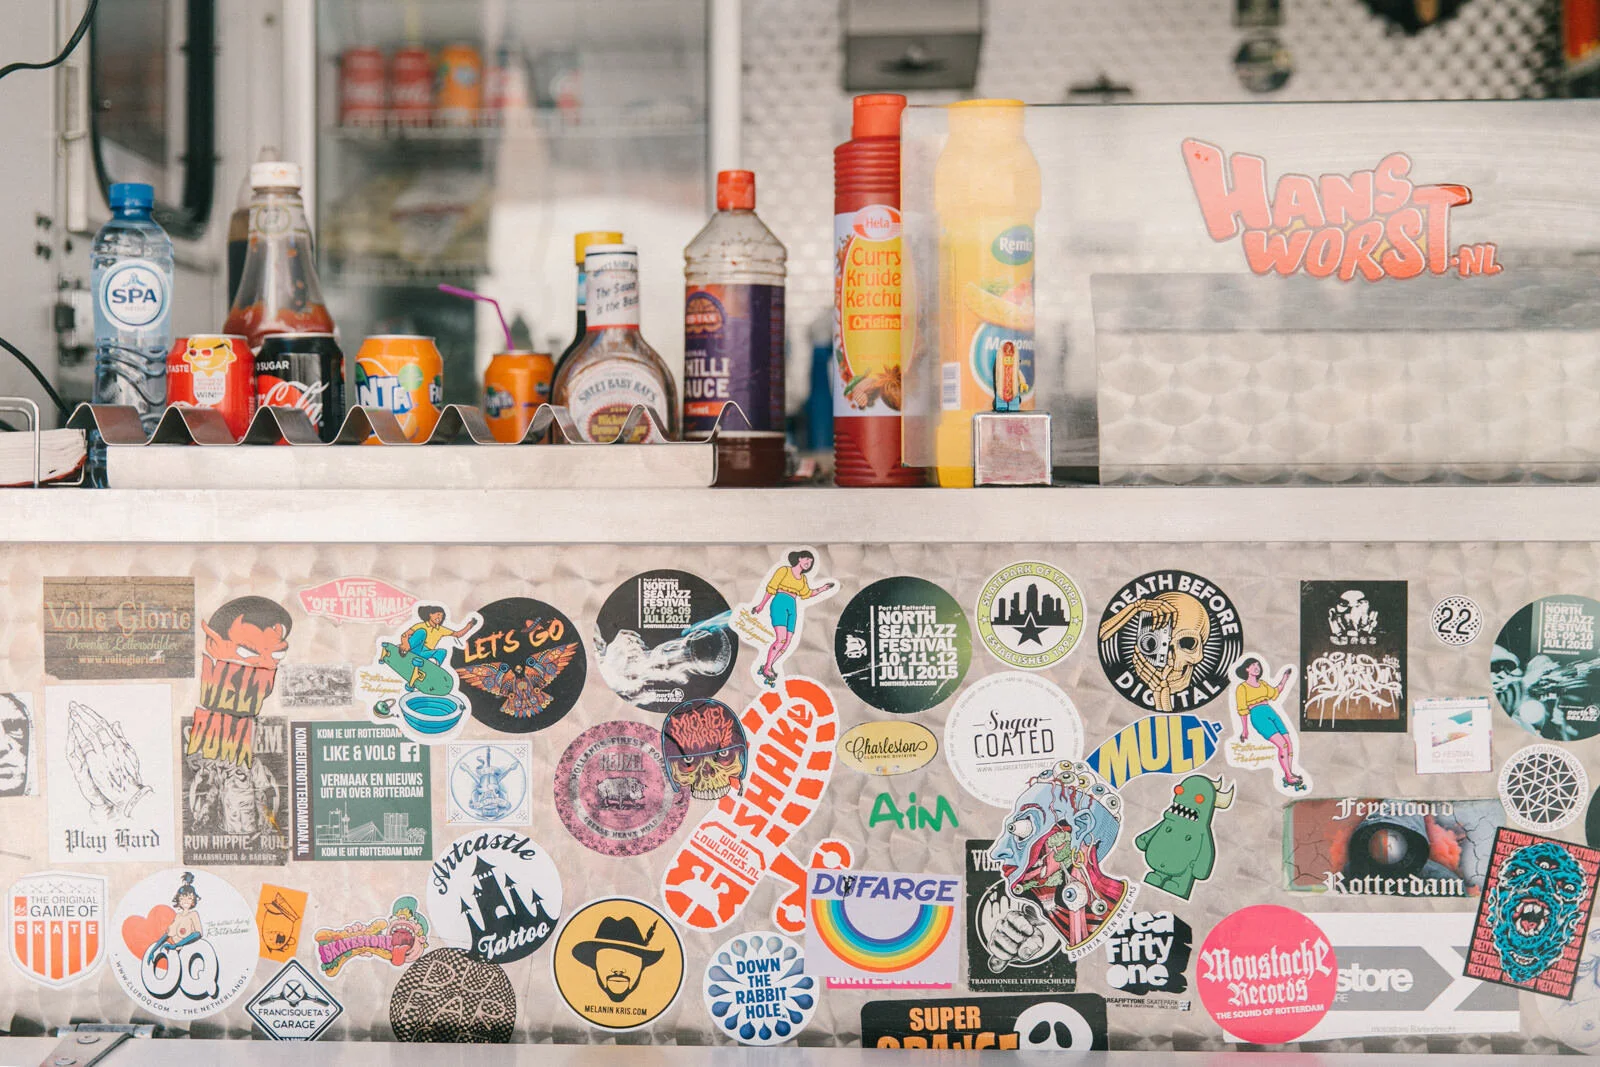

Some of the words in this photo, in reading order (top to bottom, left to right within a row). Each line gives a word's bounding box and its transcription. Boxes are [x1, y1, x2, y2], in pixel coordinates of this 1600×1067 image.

[1181, 138, 1412, 242] HANS
[866, 217, 890, 228] Hela
[847, 269, 901, 287] Kruide
[112, 289, 157, 303] SPA
[846, 290, 901, 307] Ketchu
[852, 317, 901, 329] Origina
[262, 360, 290, 371] SUGAR
[685, 357, 730, 377] HILLI
[685, 378, 730, 398] AUCE
[336, 582, 376, 597] VANS
[643, 582, 678, 590] NORTH
[643, 590, 665, 598] SEA
[666, 590, 691, 598] JAZZ
[982, 566, 1032, 607] SKATEPARK
[1036, 566, 1051, 576] OF
[1054, 573, 1078, 606] TAMPA
[342, 598, 370, 617] THE
[643, 598, 691, 606] FESTIVAL
[1109, 573, 1174, 614] DEATH
[1177, 574, 1240, 636] BEFORE
[46, 601, 106, 630] Volle
[116, 601, 191, 637] Glorie
[643, 615, 665, 623] JULI
[666, 615, 691, 623] 2017
[878, 610, 937, 624] NORTH
[1545, 606, 1582, 616] NORTH
[1438, 607, 1472, 636] 22
[1544, 624, 1594, 632] FESTIVAL
[1545, 616, 1568, 624] SEA
[1568, 616, 1594, 624] JAZZ
[878, 624, 912, 638] SEA
[914, 624, 958, 638] JAZZ
[464, 629, 520, 663] LET'S
[529, 618, 565, 647] GO
[878, 638, 958, 652] FESTIVAL
[1543, 640, 1566, 648] JULI
[1567, 640, 1594, 650] 2016
[986, 634, 1050, 666] ESTABLISHED
[879, 666, 915, 680] JULI
[917, 666, 958, 679] 2015
[201, 660, 277, 713] MELT
[985, 710, 1042, 738] Sugar
[188, 707, 252, 769] DOWN
[317, 728, 334, 738] KOM
[344, 728, 356, 738] UIT
[846, 736, 928, 762] Charleston
[974, 728, 1054, 758] COATED
[323, 745, 350, 761] LIKE
[353, 746, 362, 761] &
[364, 745, 396, 761] VOLG
[320, 774, 368, 786] VERMAAK
[370, 773, 384, 786] EN
[386, 772, 423, 786] NIEUWS
[320, 787, 334, 798] UIT
[336, 787, 348, 798] EN
[349, 786, 371, 798] OVER
[373, 786, 424, 798] ROTTERDAM
[1332, 798, 1454, 820] Feyenoord
[65, 829, 107, 853] Play
[115, 829, 160, 852] Hard
[184, 835, 208, 849] RUN
[321, 847, 337, 857] KOM
[347, 847, 358, 857] UIT
[360, 847, 402, 856] ROTTERDAM
[404, 847, 423, 856] DAN?
[432, 833, 536, 895] Artcastle
[812, 873, 958, 902] DUFARGE
[1323, 872, 1465, 896] Rotterdam
[31, 896, 49, 904] THE
[52, 896, 98, 904] ORIGINAL
[30, 905, 75, 917] GAME
[78, 905, 98, 917] OF
[17, 924, 97, 934] SKATE
[478, 922, 550, 960] Tattoo
[1072, 936, 1100, 960] SOPHIA
[1102, 920, 1118, 937] DEN
[1105, 932, 1174, 964] Fifty
[736, 958, 781, 975] DOWN
[1200, 936, 1332, 982] Moustache
[748, 974, 772, 988] THE
[1020, 978, 1076, 986] LETTERSCHILDER
[1106, 964, 1168, 988] one
[736, 987, 788, 1005] RABBIT
[1226, 976, 1309, 1007] Records
[258, 1008, 330, 1018] FRANCISQUETA'S
[584, 1005, 614, 1014] MELANIN
[616, 1008, 647, 1016] KRIS.COM
[746, 1003, 782, 1019] HOLE
[1216, 1012, 1232, 1020] THE
[1232, 1010, 1261, 1018] SOUND
[1262, 1008, 1274, 1016] OF
[1275, 1004, 1324, 1014] ROTTERDAM
[273, 1020, 316, 1029] GARAGE
[909, 1006, 982, 1032] SUPER
